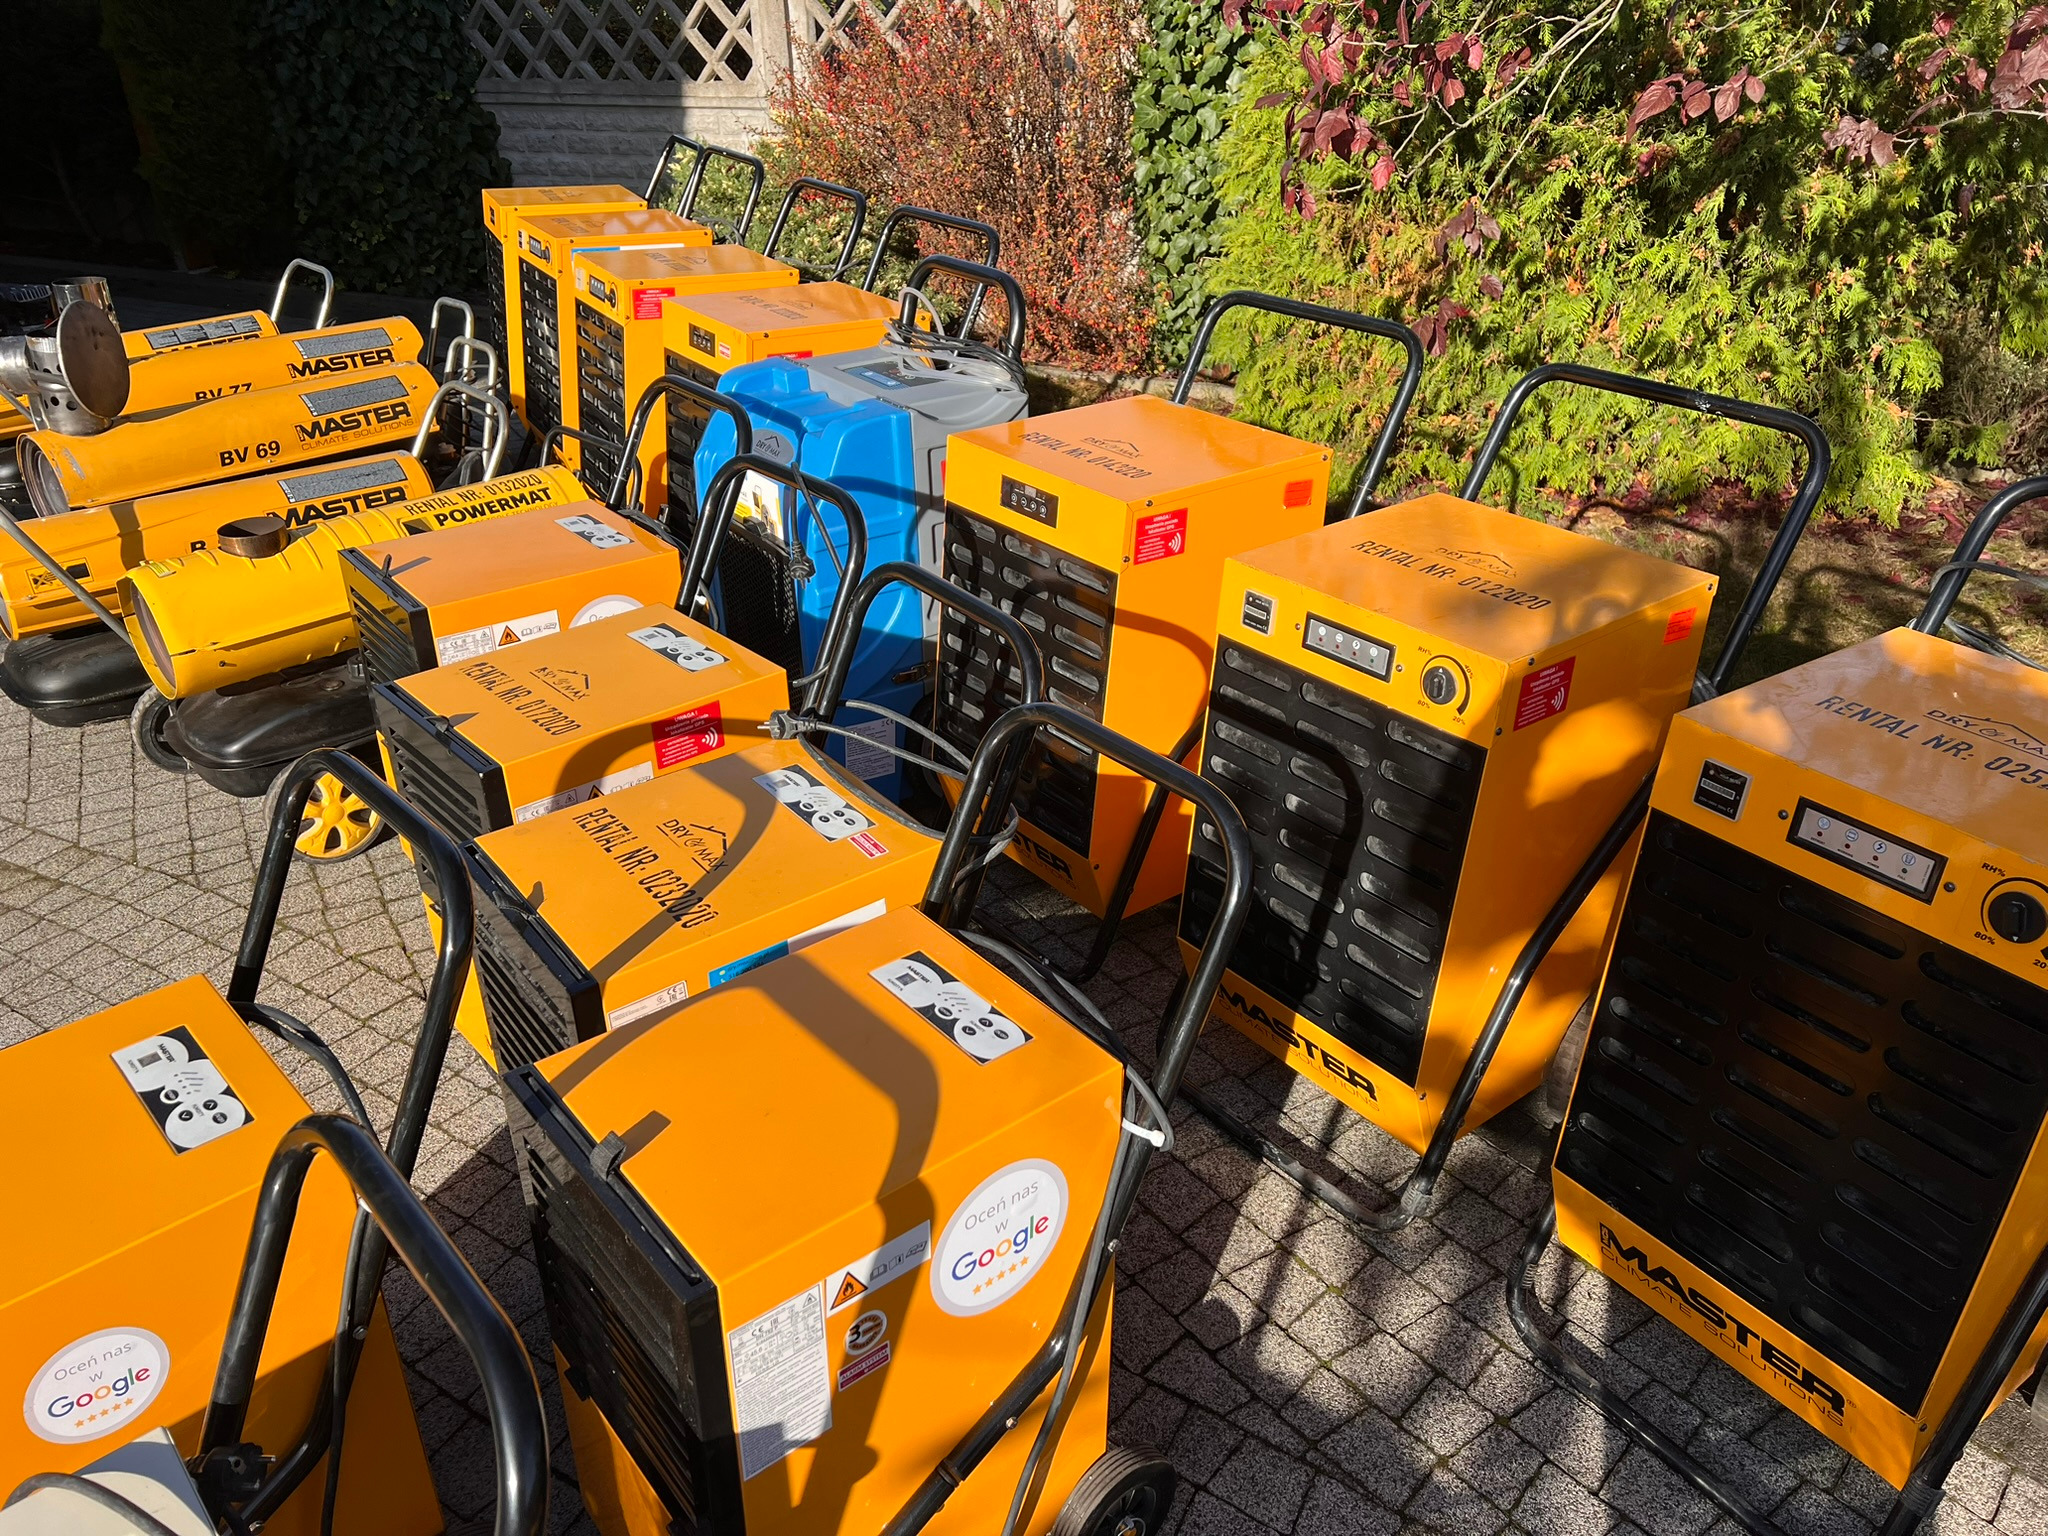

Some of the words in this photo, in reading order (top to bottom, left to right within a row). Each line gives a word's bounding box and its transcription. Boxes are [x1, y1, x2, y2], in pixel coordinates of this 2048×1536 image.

[287, 348, 396, 379] MASTER
[295, 402, 412, 442] MASTER
[301, 434, 350, 451] CLIMATE
[353, 418, 414, 438] SOLUTIONS
[219, 446, 249, 467] BV
[256, 441, 281, 460] 69
[266, 486, 408, 529] MASTER
[403, 494, 460, 516] RENTAL
[484, 473, 543, 496] 0132020
[433, 487, 553, 527] POWERMAT
[1350, 540, 1423, 568] RENTAL
[1457, 576, 1552, 610] 0122020
[515, 699, 581, 736] 0172020
[1926, 709, 1979, 728] DRY
[2003, 738, 2048, 757] MA
[1815, 695, 1920, 739] RENTAL
[1984, 756, 2048, 790] 025
[663, 818, 693, 838] DRY
[694, 847, 729, 872] MAX
[572, 807, 638, 853] RENTAL
[638, 869, 719, 929] 0232020
[1981, 862, 2006, 877] RH%
[1973, 931, 1996, 945] 80%
[2032, 959, 2048, 972] 20
[1218, 984, 1378, 1102] MASTER
[1288, 1045, 1381, 1112] SOLUTIONS
[965, 1198, 1007, 1231] Oceń
[1011, 1181, 1039, 1205] nas
[994, 1218, 1009, 1234] w
[952, 1215, 1049, 1281] Google
[1600, 1222, 1846, 1418] MASTER
[1601, 1246, 1693, 1319] CLIMATE
[1703, 1320, 1844, 1428] SOLUTIONS
[54, 1354, 98, 1382] Oceń
[102, 1341, 132, 1363] nas
[89, 1370, 104, 1382] w
[47, 1367, 151, 1418] Google
